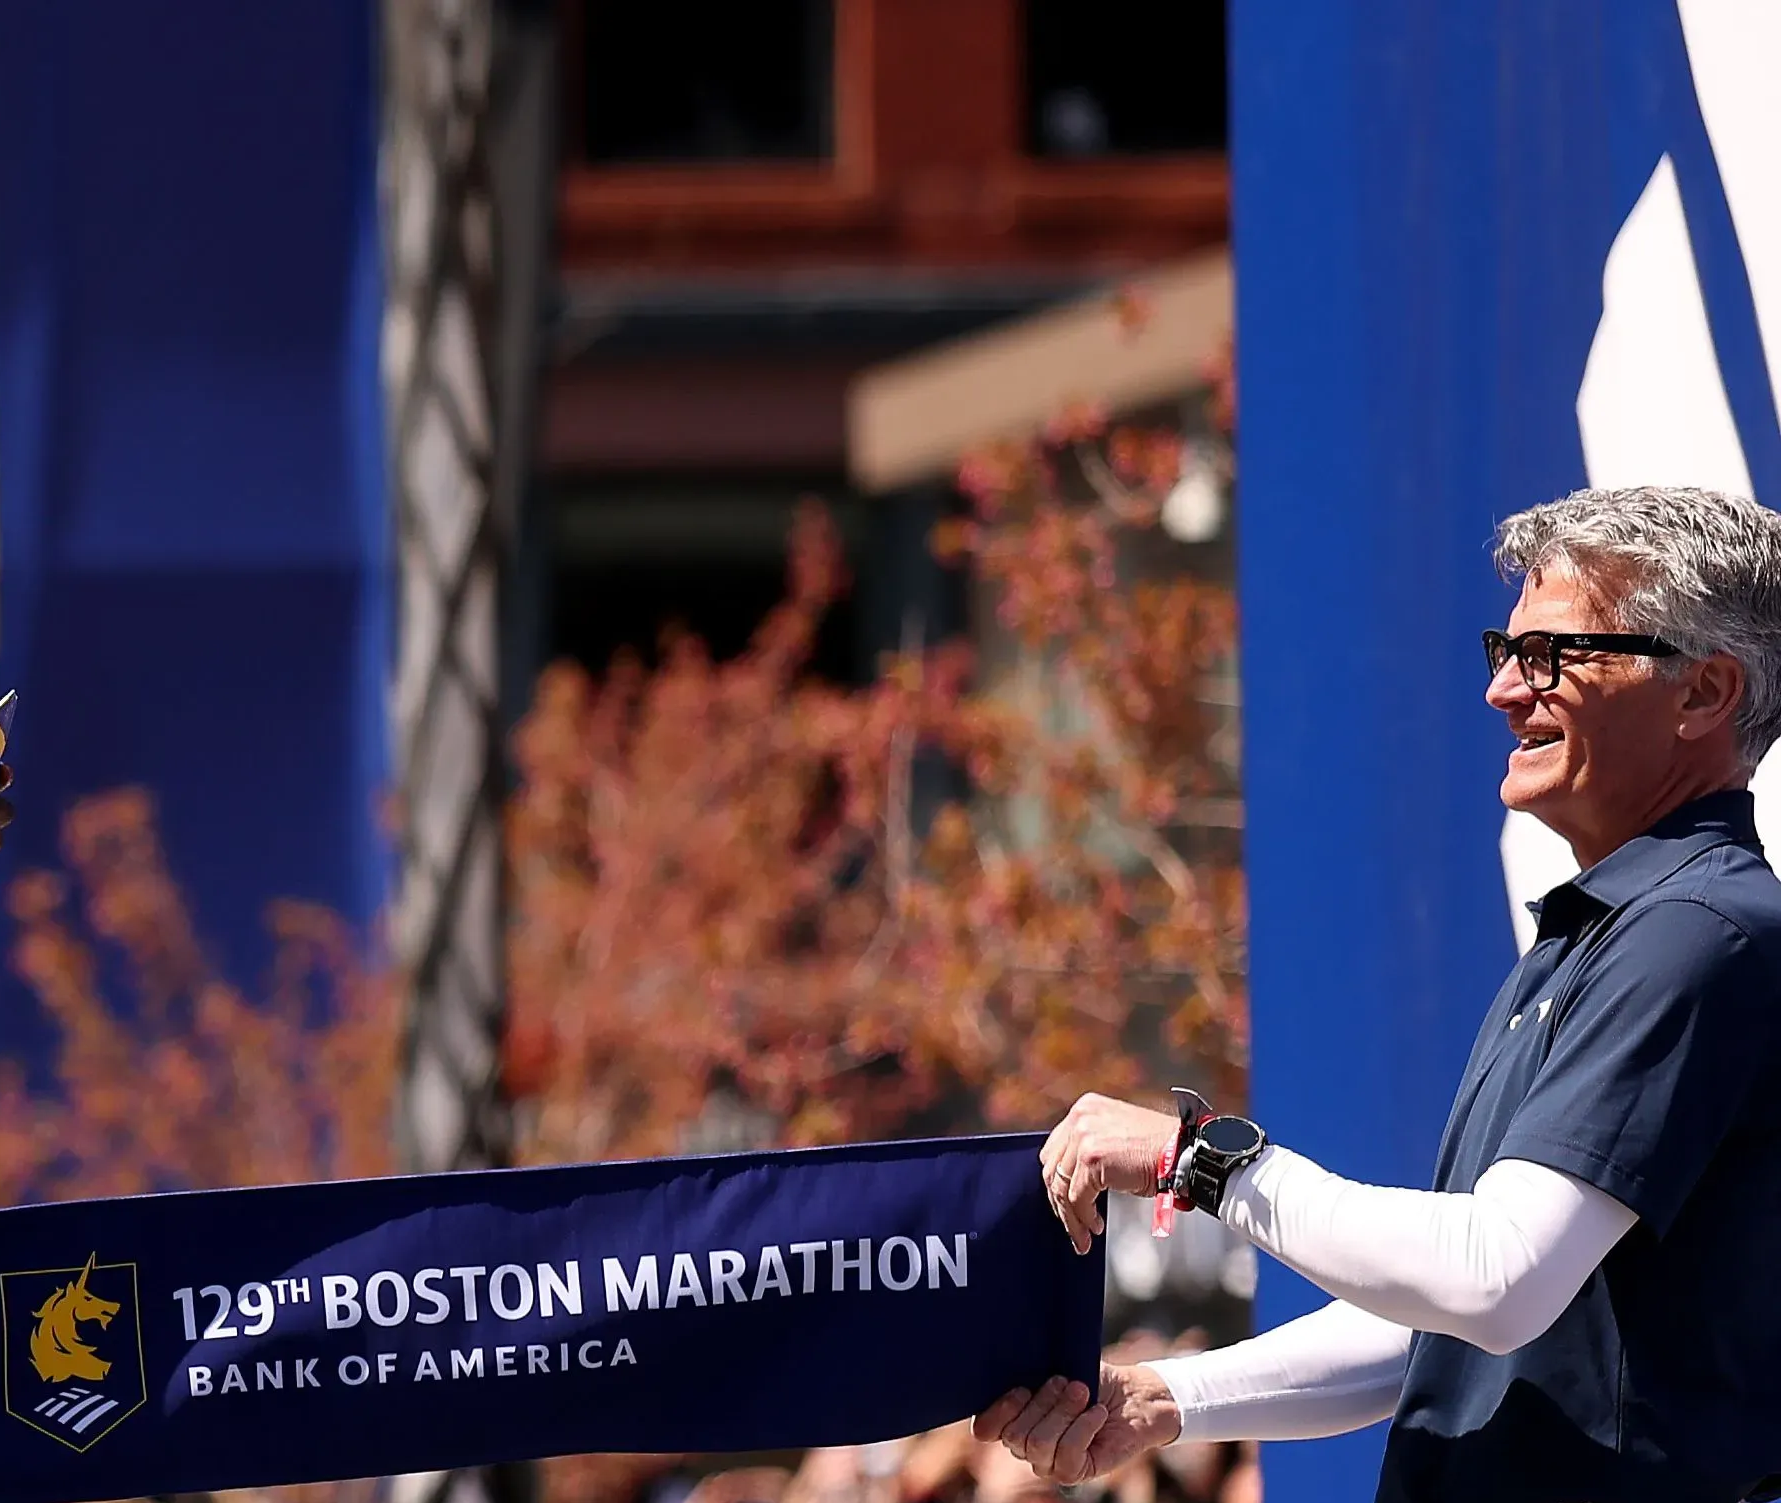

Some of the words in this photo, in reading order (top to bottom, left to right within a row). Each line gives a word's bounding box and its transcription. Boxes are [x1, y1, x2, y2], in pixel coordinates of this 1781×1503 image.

[172, 1277, 311, 1341] 129TH
[321, 1260, 584, 1330] BOSTON
[601, 1233, 969, 1313] MARATHON
[188, 1357, 321, 1397] BANK
[338, 1352, 398, 1386] OF
[413, 1338, 638, 1383] AMERICA
